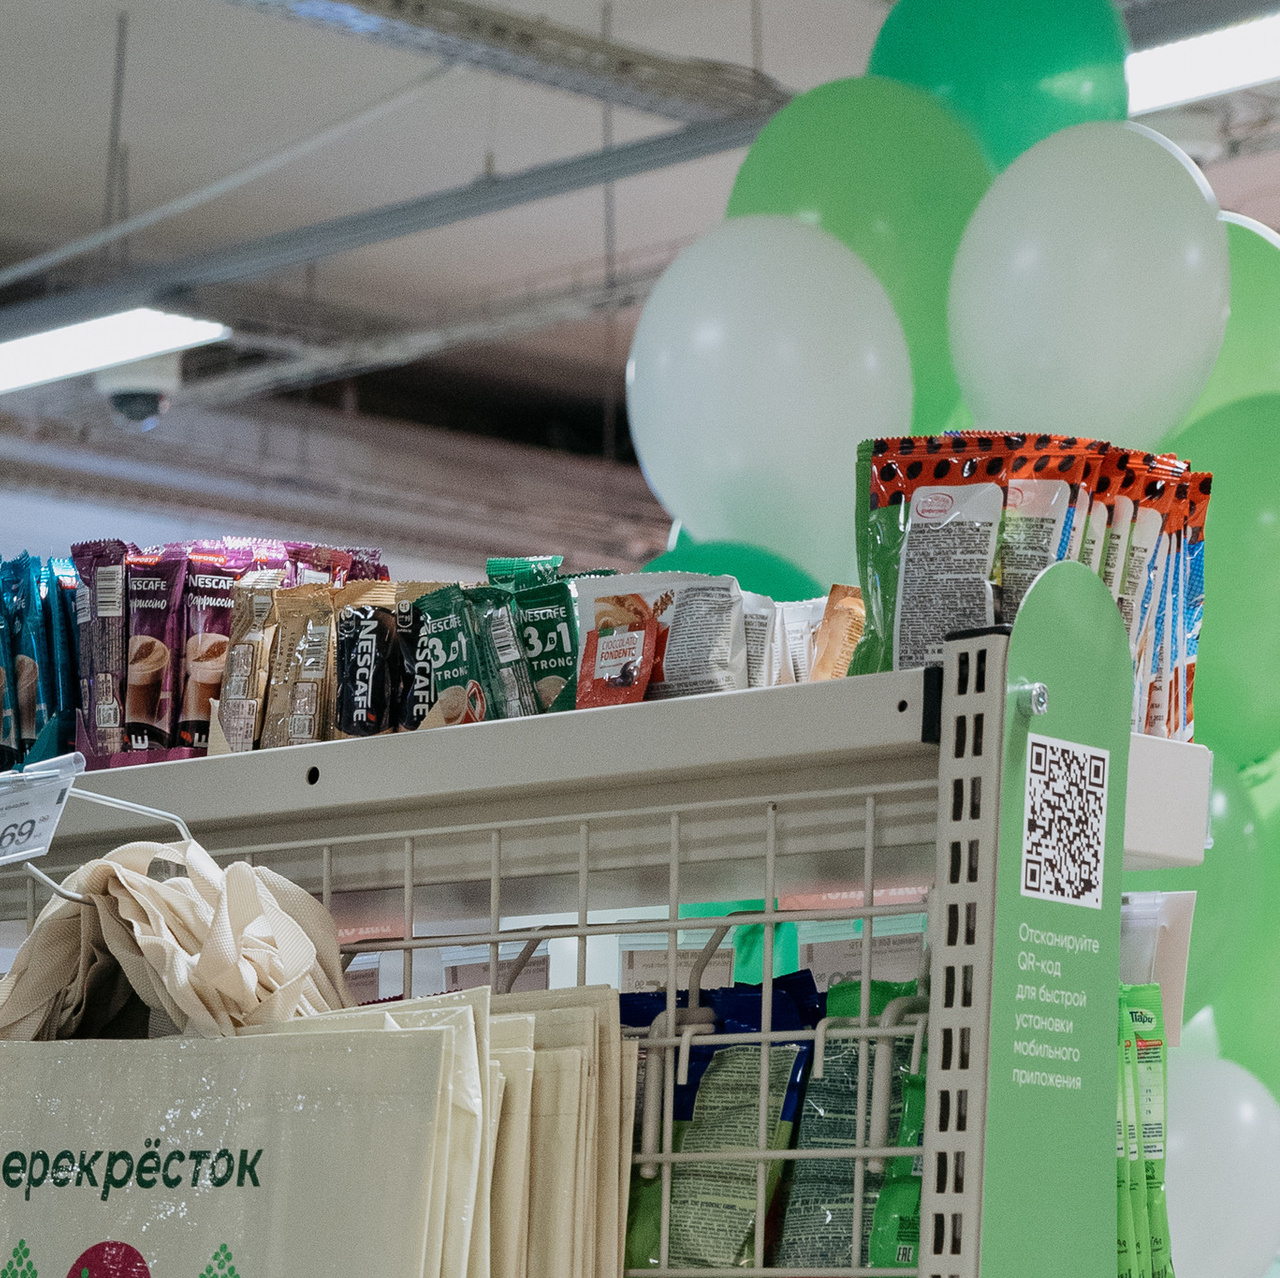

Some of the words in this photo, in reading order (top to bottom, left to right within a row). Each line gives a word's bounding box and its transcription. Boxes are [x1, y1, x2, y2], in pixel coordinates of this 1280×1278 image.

[187, 592, 235, 613] Cappuccin
[1018, 922, 1100, 954] Отсканируйте
[1017, 951, 1062, 978] QR-код
[1016, 983, 1037, 1002] для
[1038, 984, 1087, 1008] быстрой
[1014, 1013, 1074, 1035] установки
[1013, 1039, 1081, 1063] мобильного
[1012, 1068, 1082, 1090] приложения
